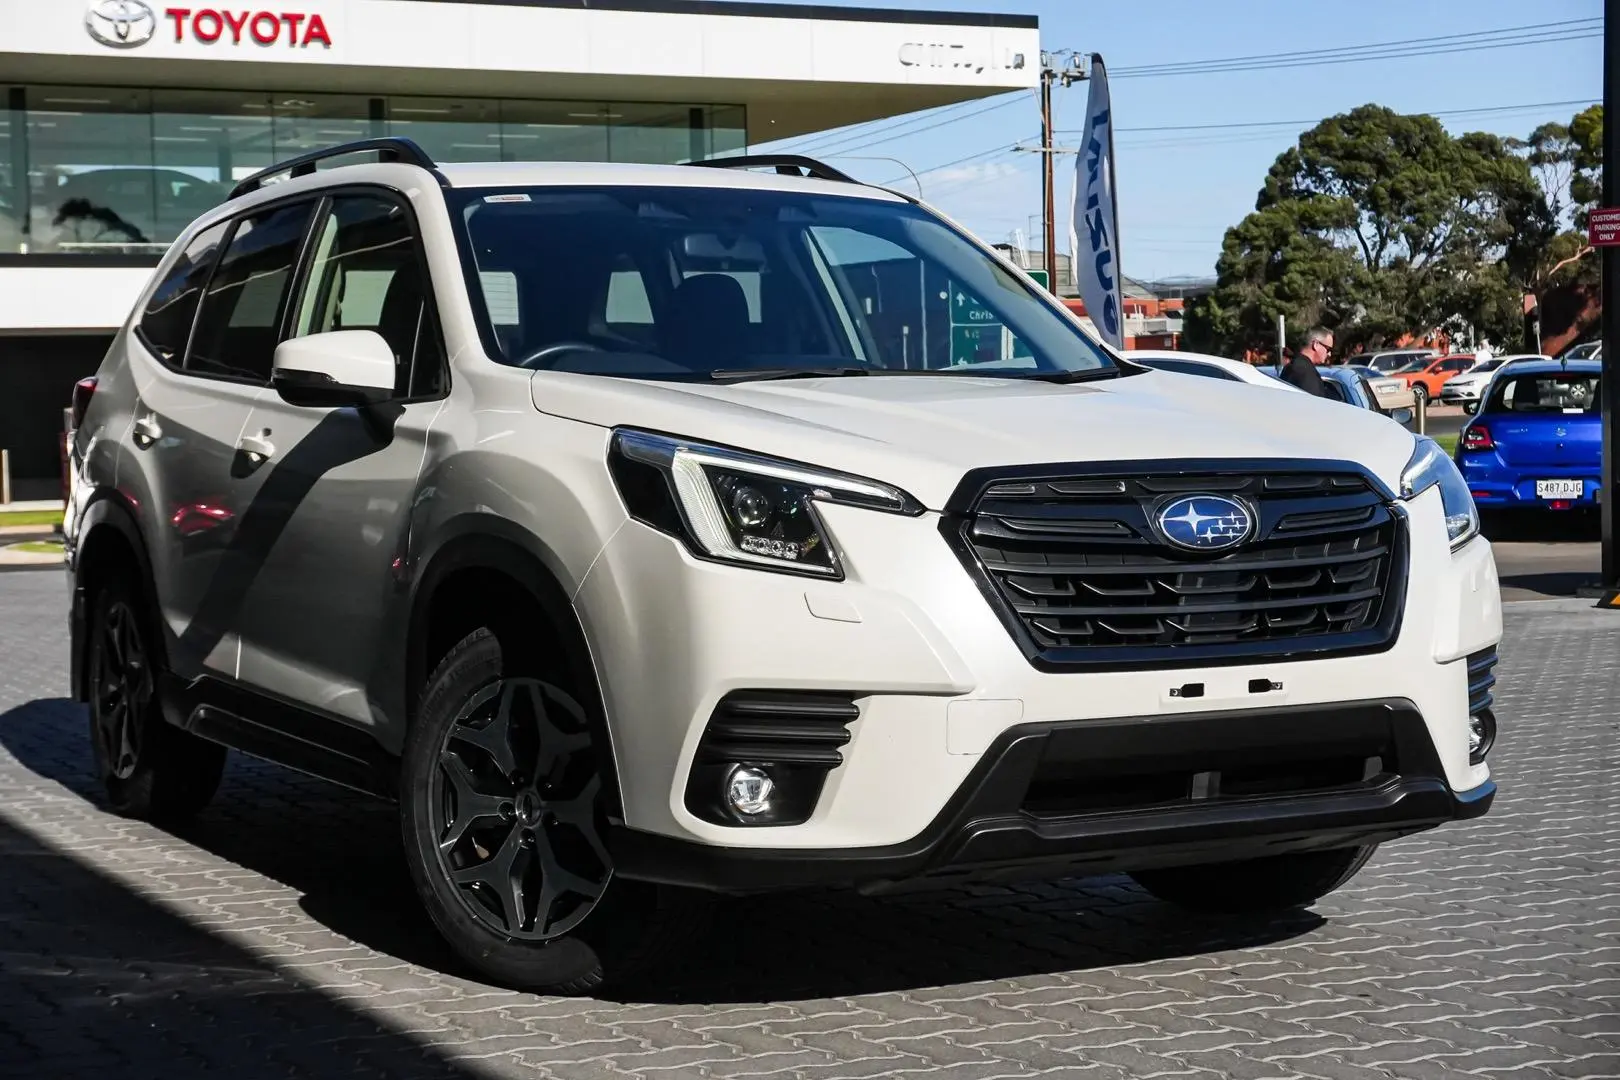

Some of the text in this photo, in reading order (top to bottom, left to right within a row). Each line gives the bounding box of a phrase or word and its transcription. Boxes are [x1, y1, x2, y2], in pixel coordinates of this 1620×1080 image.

[165, 8, 331, 49] TOYOTA
[1599, 233, 1615, 241] ONLY
[1563, 482, 1582, 493] DJG
